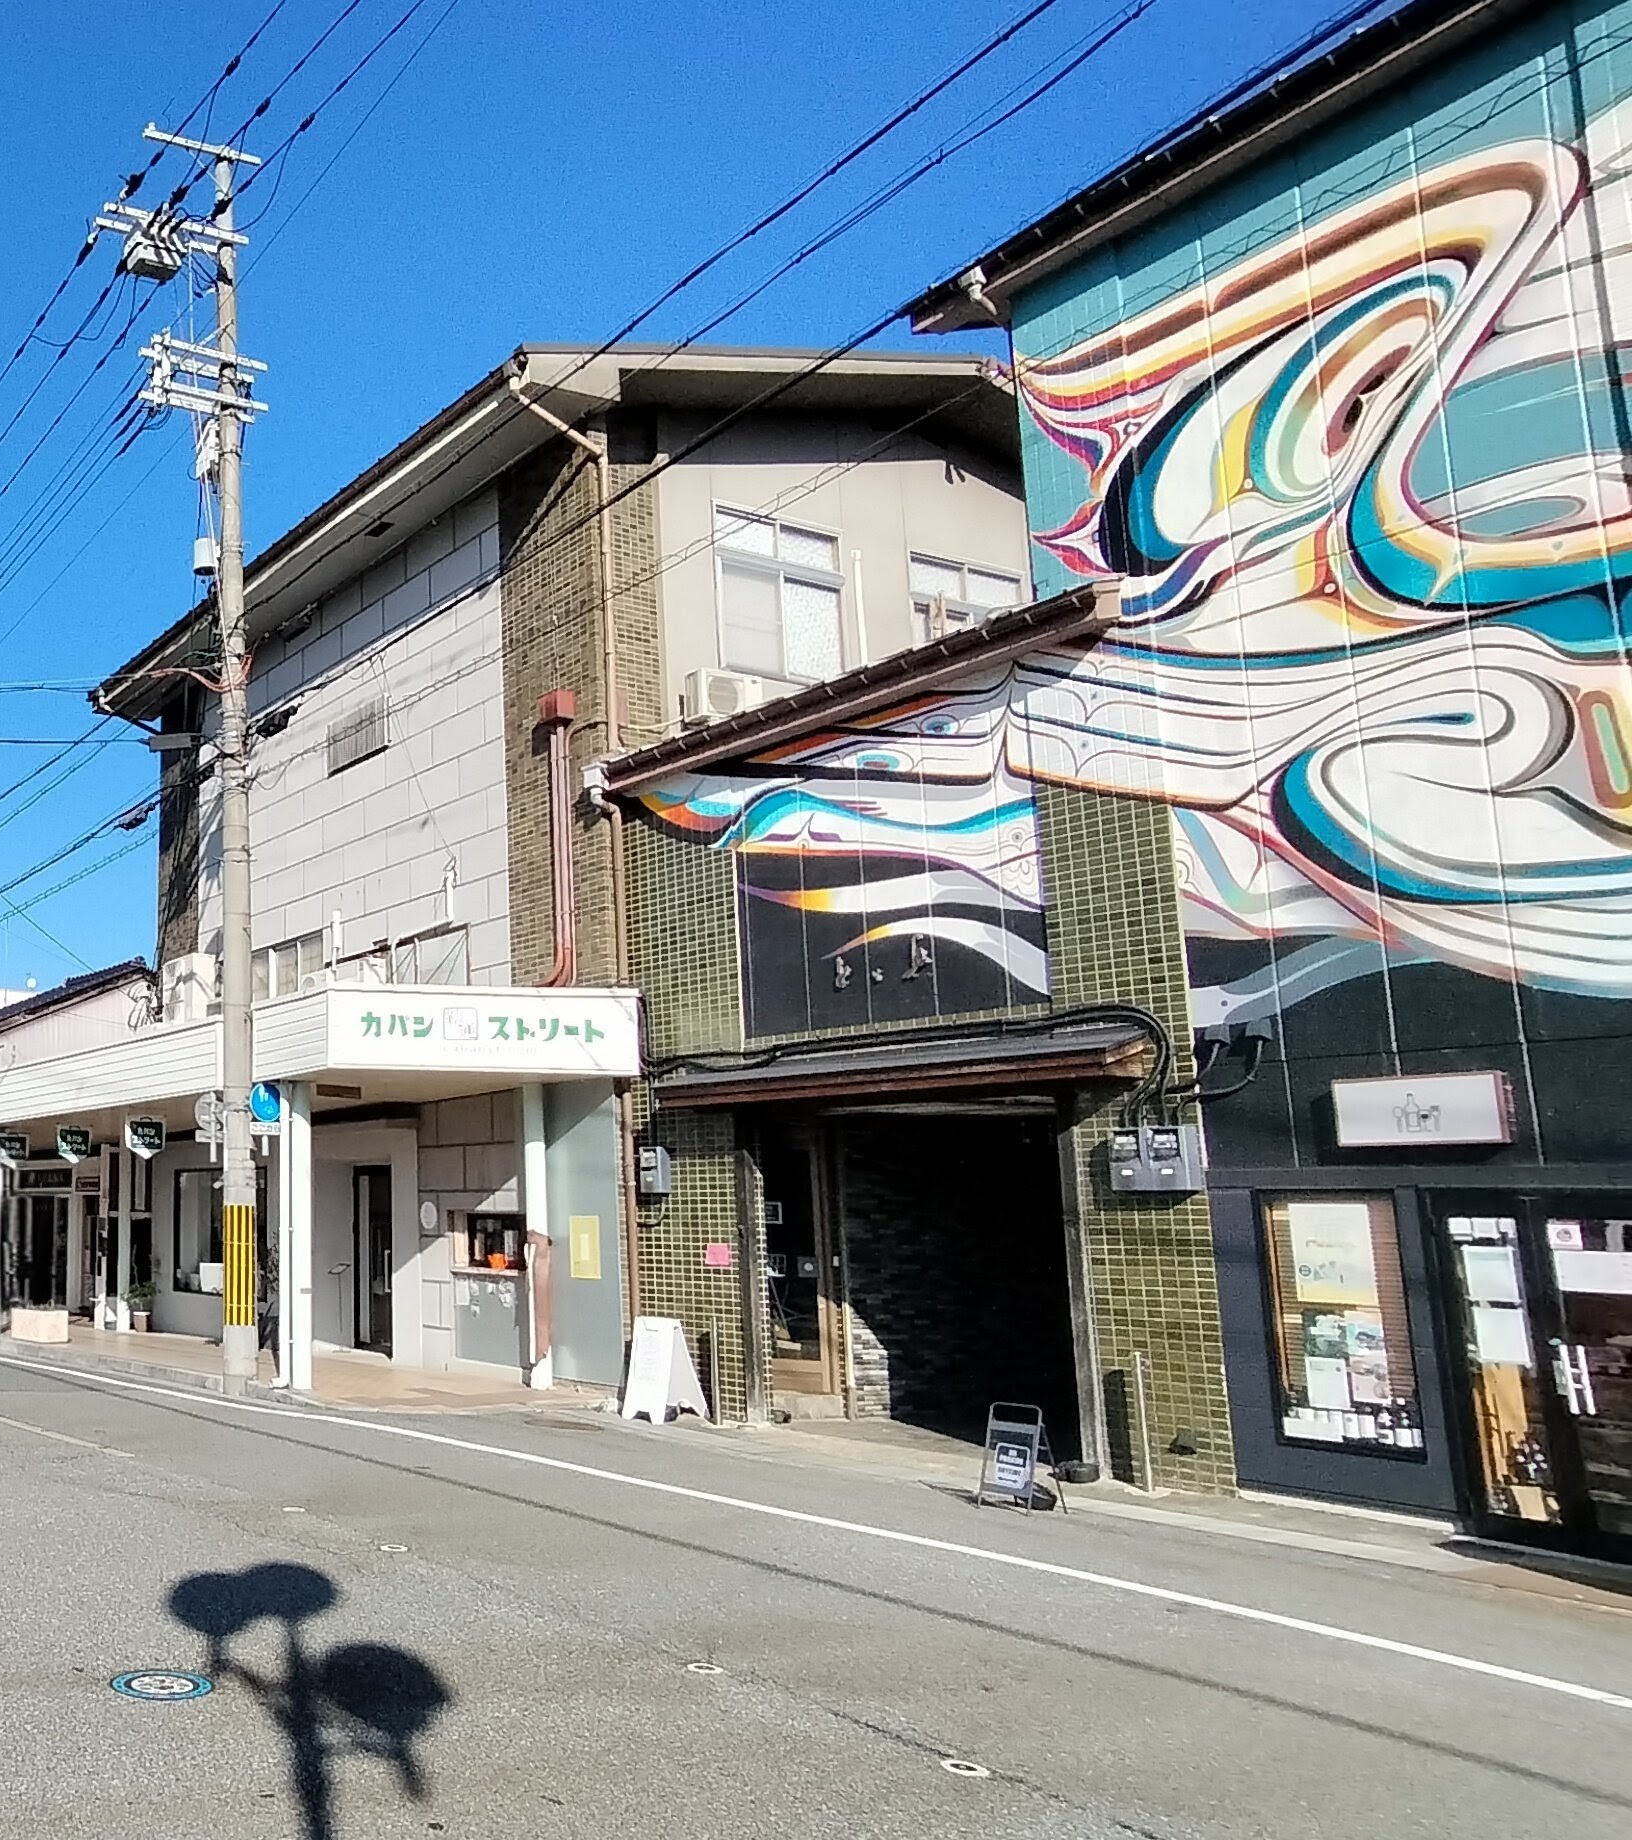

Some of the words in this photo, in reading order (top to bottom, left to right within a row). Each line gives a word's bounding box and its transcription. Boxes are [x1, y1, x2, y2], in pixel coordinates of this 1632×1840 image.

[360, 1011, 434, 1038] カバン
[488, 1016, 605, 1042] ストリート
